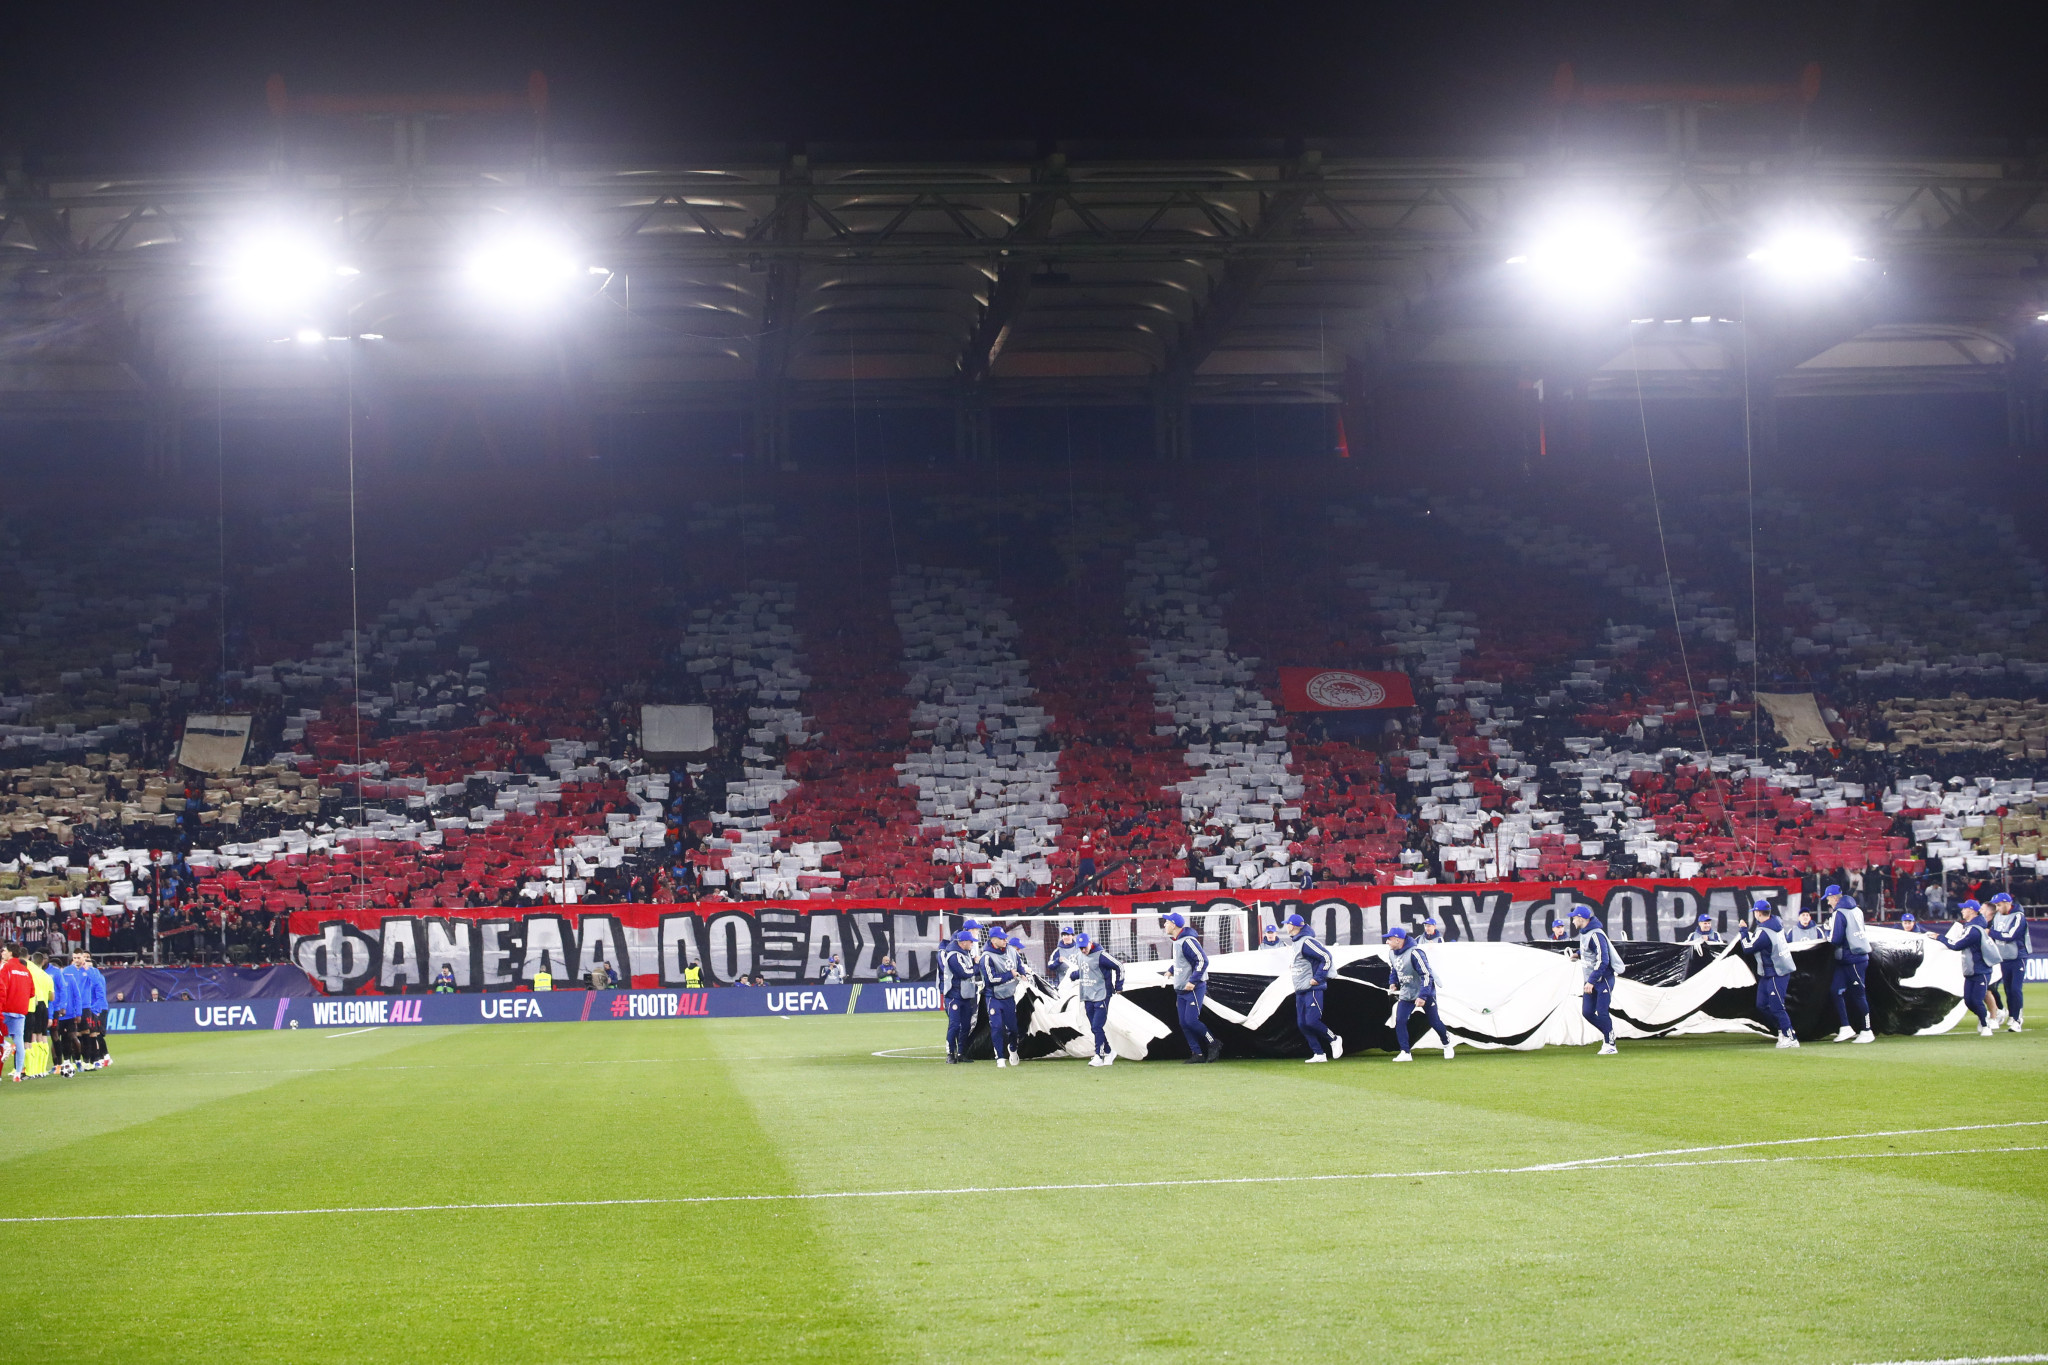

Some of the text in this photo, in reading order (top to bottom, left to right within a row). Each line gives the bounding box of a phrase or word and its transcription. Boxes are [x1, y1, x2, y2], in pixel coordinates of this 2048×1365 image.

[481, 999, 543, 1019] UEFA
[610, 993, 709, 1018] #FOOTBALL
[767, 991, 828, 1012] UEFA
[885, 986, 942, 1010] WELCO
[195, 1005, 257, 1026] UEFA
[312, 999, 423, 1025] WELCOME ALL
